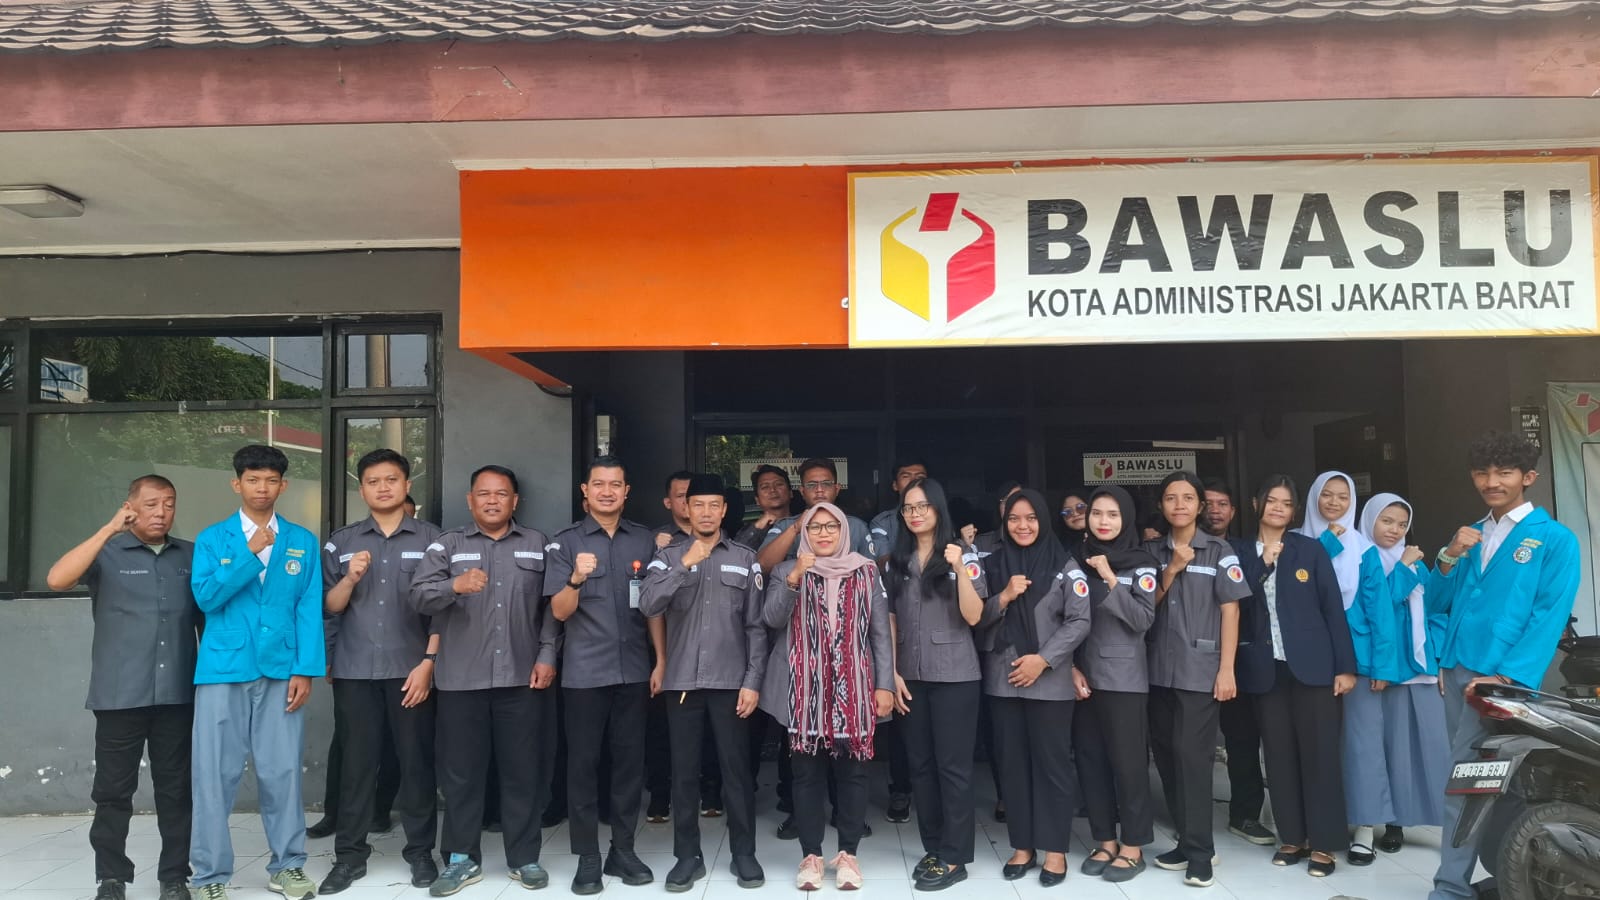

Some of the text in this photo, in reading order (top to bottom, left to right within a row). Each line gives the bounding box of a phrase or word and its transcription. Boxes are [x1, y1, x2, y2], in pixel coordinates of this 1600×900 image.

[1028, 188, 1572, 275] BAWASLU
[1029, 280, 1575, 317] KOTA ADMINISTRASI JAKARTA BARAT
[1117, 459, 1183, 470] BAWASLU
